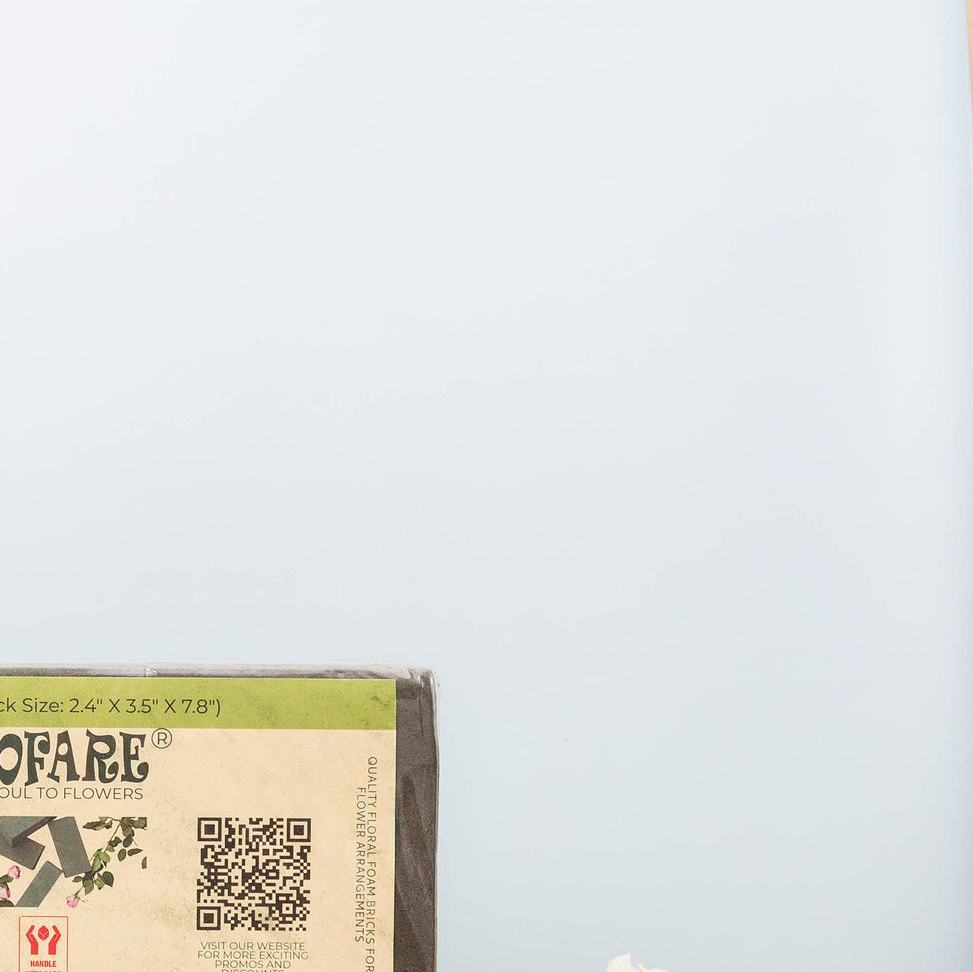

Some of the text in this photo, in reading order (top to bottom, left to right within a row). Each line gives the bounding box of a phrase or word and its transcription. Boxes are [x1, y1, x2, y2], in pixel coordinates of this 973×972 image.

[22, 697, 65, 713] Size:
[69, 698, 104, 713] 2.4"
[108, 698, 121, 713] X
[125, 698, 159, 714] 3.5"
[164, 698, 177, 714] X
[181, 698, 222, 718] 7.8")
[37, 786, 59, 800] TO
[62, 787, 144, 801] FLOWERS
[354, 787, 367, 943] FLOWER ARRANGEMENTS
[365, 756, 378, 972] QUALITY FLORAL FOAM BRICKS FOR
[200, 941, 306, 951] VISIT OUR WEBSITE
[197, 950, 309, 960] FOR MORE EXCITING
[30, 960, 57, 968] HANDLE
[215, 959, 292, 969] PROMOS AND
